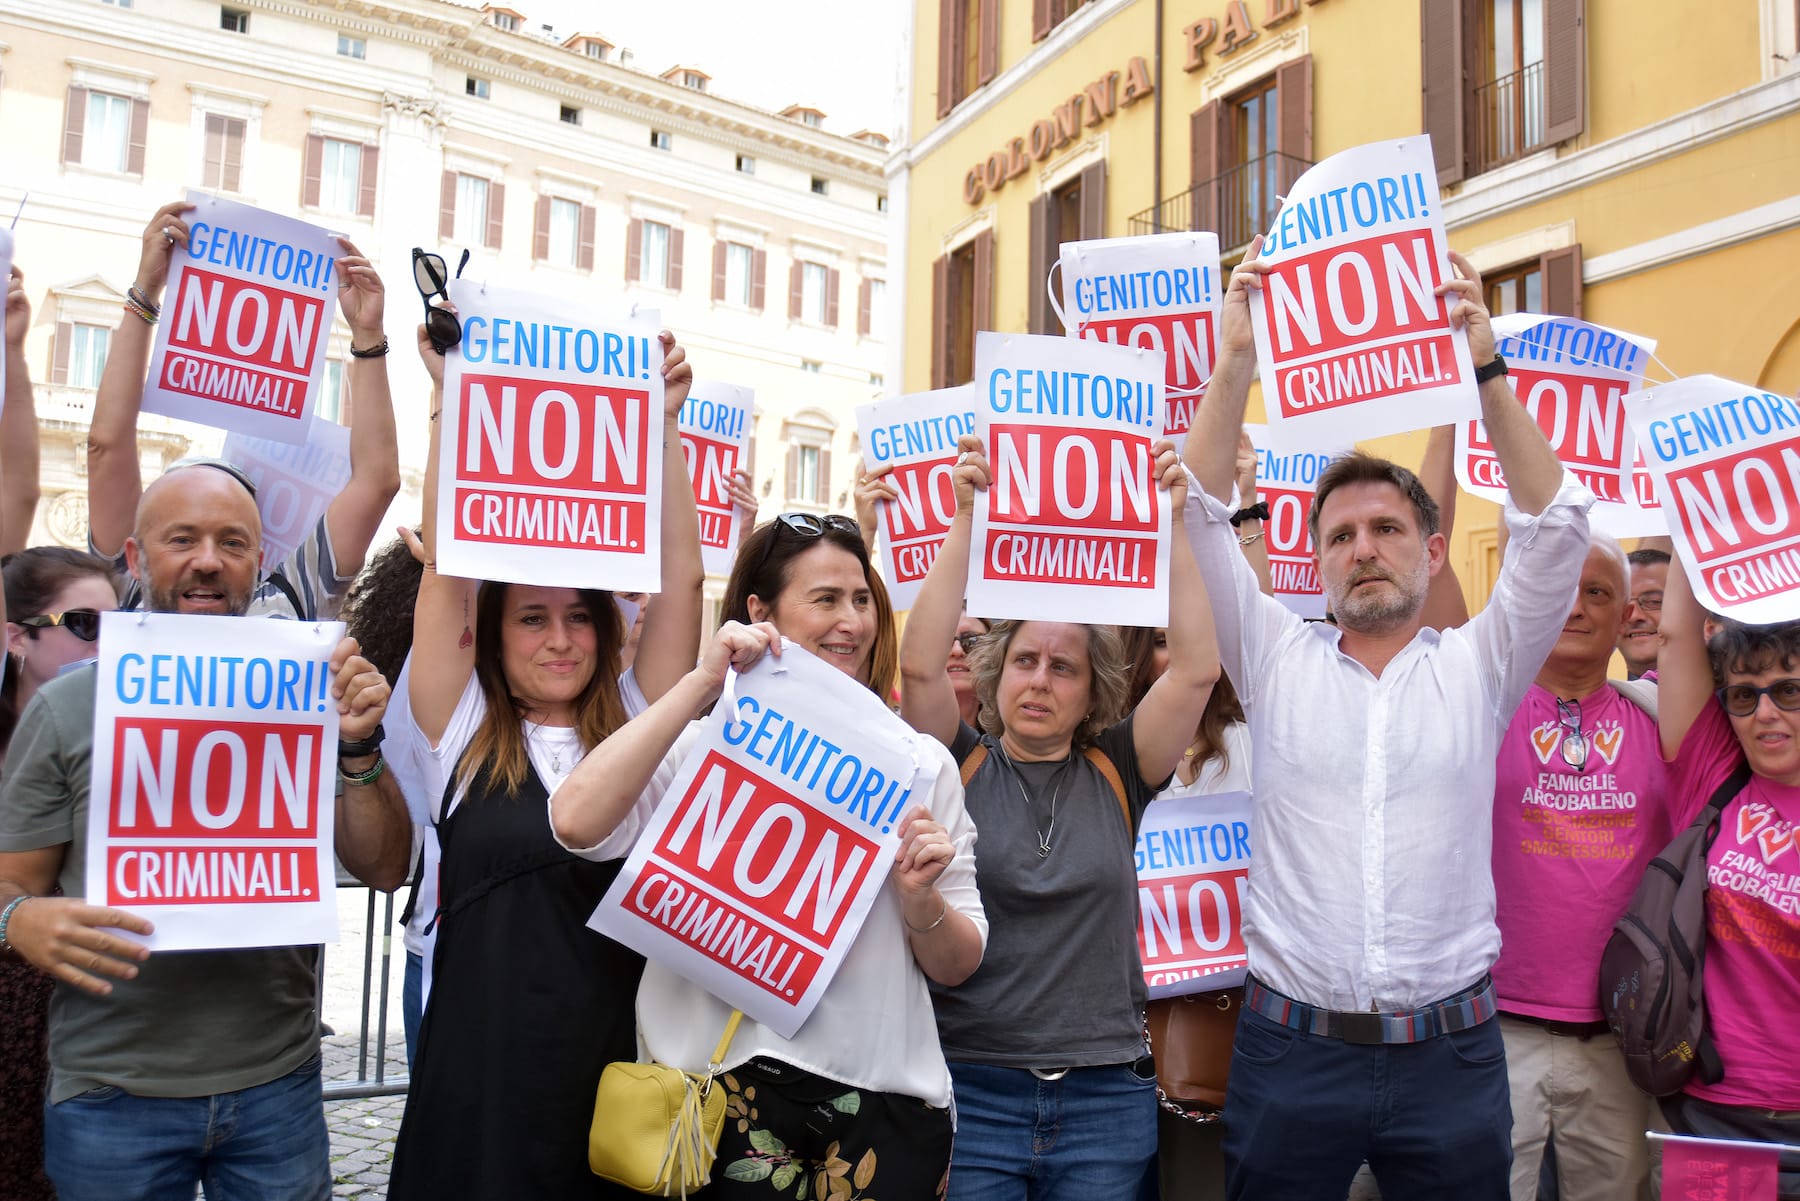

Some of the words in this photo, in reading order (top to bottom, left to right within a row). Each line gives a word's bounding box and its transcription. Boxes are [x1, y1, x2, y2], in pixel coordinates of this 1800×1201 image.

[964, 56, 1154, 205] COLONNA
[1183, 0, 1303, 73] PAL
[1261, 172, 1430, 257] GENITORI!
[187, 222, 334, 292] GENITORI!
[175, 273, 317, 369] NON
[1075, 266, 1212, 314] GENITORI!
[1268, 237, 1441, 353] NON
[463, 316, 650, 380] GENITORI!
[1284, 342, 1453, 409] CRIMINALI.
[1499, 322, 1639, 371] ENITORI!
[167, 356, 297, 414] CRIMINALI.
[989, 368, 1154, 427] GENITORI!
[465, 383, 641, 486] NON
[679, 398, 745, 439] ITORI!
[870, 412, 975, 461] GENITOR
[1649, 393, 1800, 462] GENITORI
[885, 464, 958, 535] NO
[996, 432, 1152, 523] NON
[461, 493, 638, 548] CRIMINALI.
[991, 534, 1149, 584] CRIMINALI.
[117, 653, 328, 712] GENITORI!
[118, 727, 313, 829] NON
[722, 696, 912, 834] GENITORI!
[1538, 773, 1618, 792] FAMIGLIE
[1521, 787, 1637, 811] ARCOBALENO
[666, 763, 867, 936] NON
[1134, 822, 1251, 872] GENITOR
[1543, 825, 1615, 844] GENITORI
[115, 851, 312, 898] CRIMINALI.
[1707, 865, 1800, 916] RCOBALEN
[635, 872, 805, 997] CRIMINALI.
[1139, 876, 1249, 958] NO
